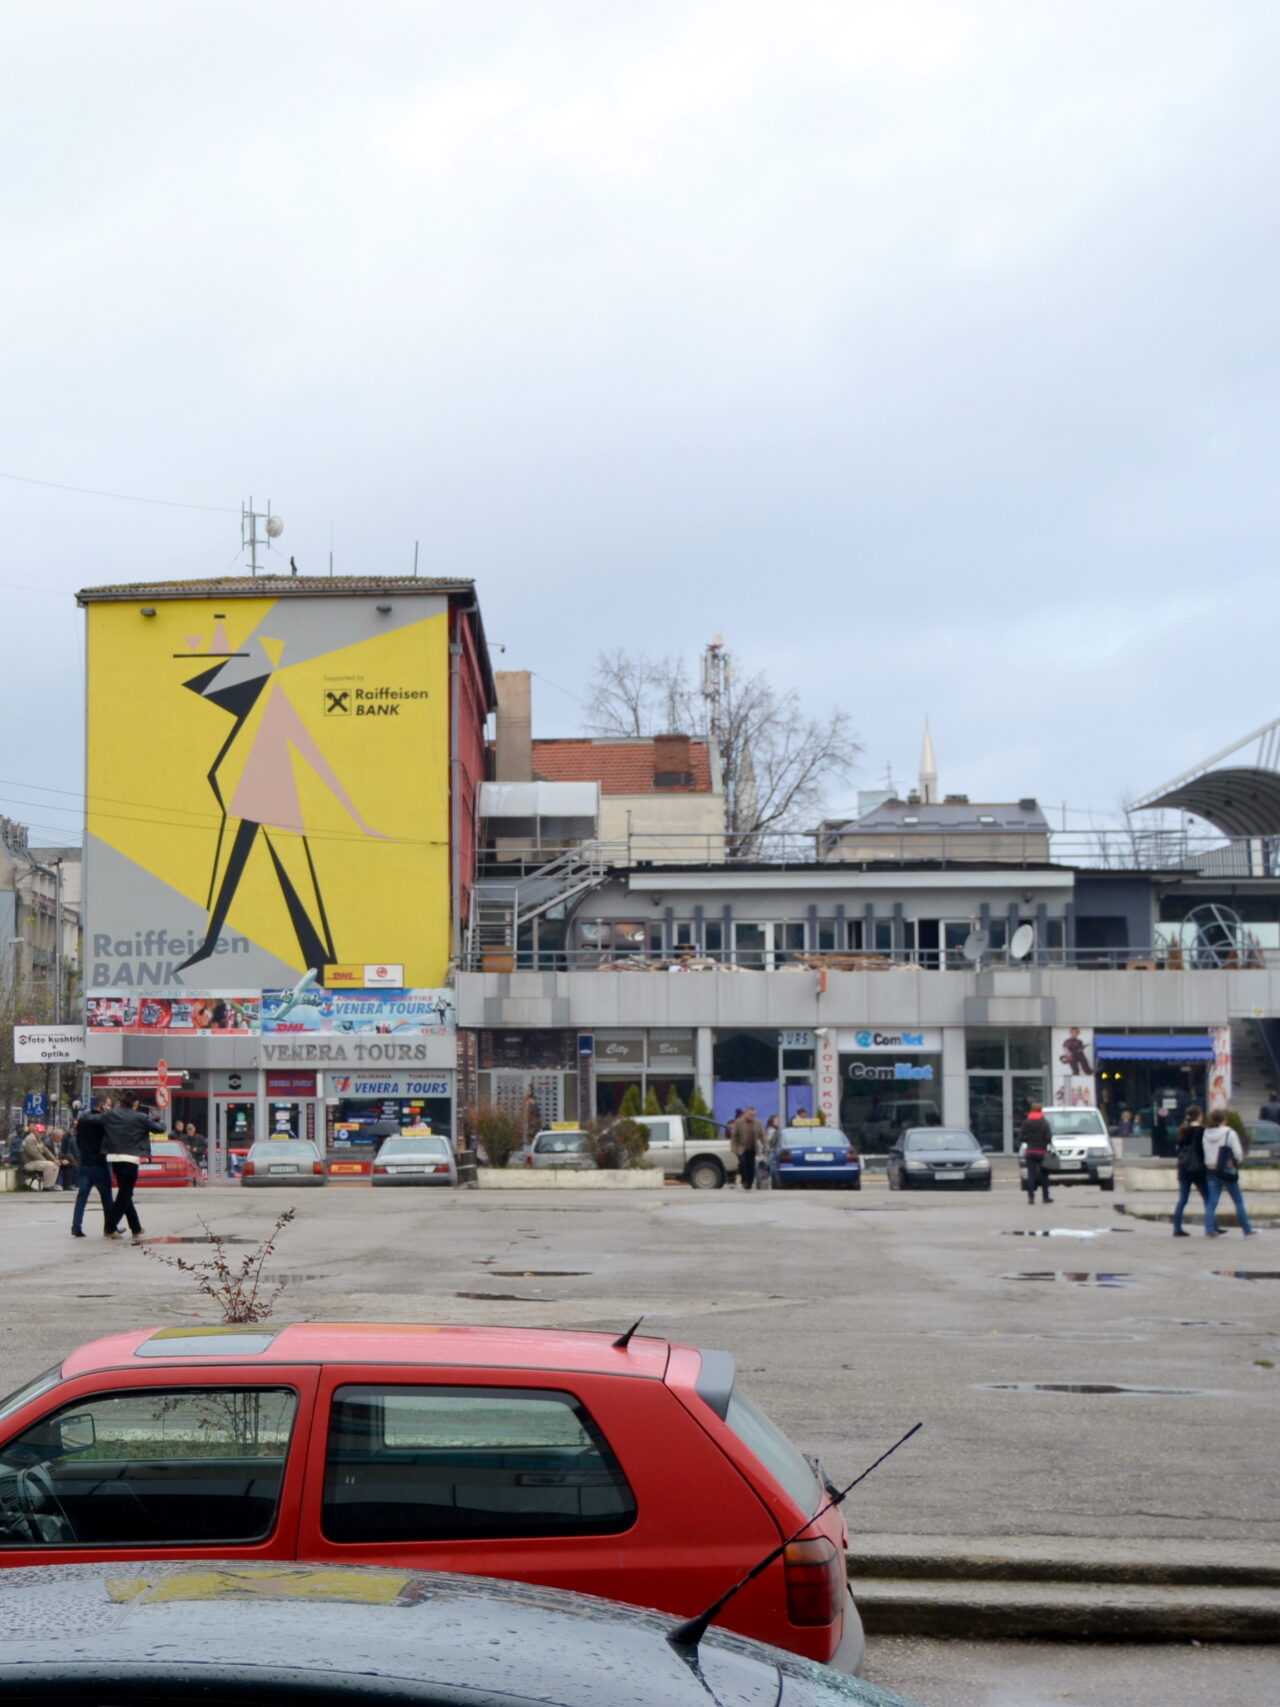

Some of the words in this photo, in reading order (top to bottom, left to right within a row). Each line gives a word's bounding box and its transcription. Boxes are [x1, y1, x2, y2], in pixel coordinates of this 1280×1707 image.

[355, 687, 429, 700] Raiffeisen
[356, 704, 401, 716] BANK
[92, 961, 185, 987] BANK
[335, 1002, 384, 1015] VENERA
[389, 1002, 433, 1015] TOURS
[276, 1023, 306, 1032] DHL
[873, 1033, 925, 1046] ComNet
[41, 1051, 70, 1059] Optika
[263, 1044, 348, 1062] VENERA
[354, 1044, 427, 1062] TOURS
[605, 1043, 629, 1056] City
[848, 1062, 934, 1080] ComNet
[354, 1082, 400, 1094] VENERA
[406, 1082, 449, 1094] TOURS
